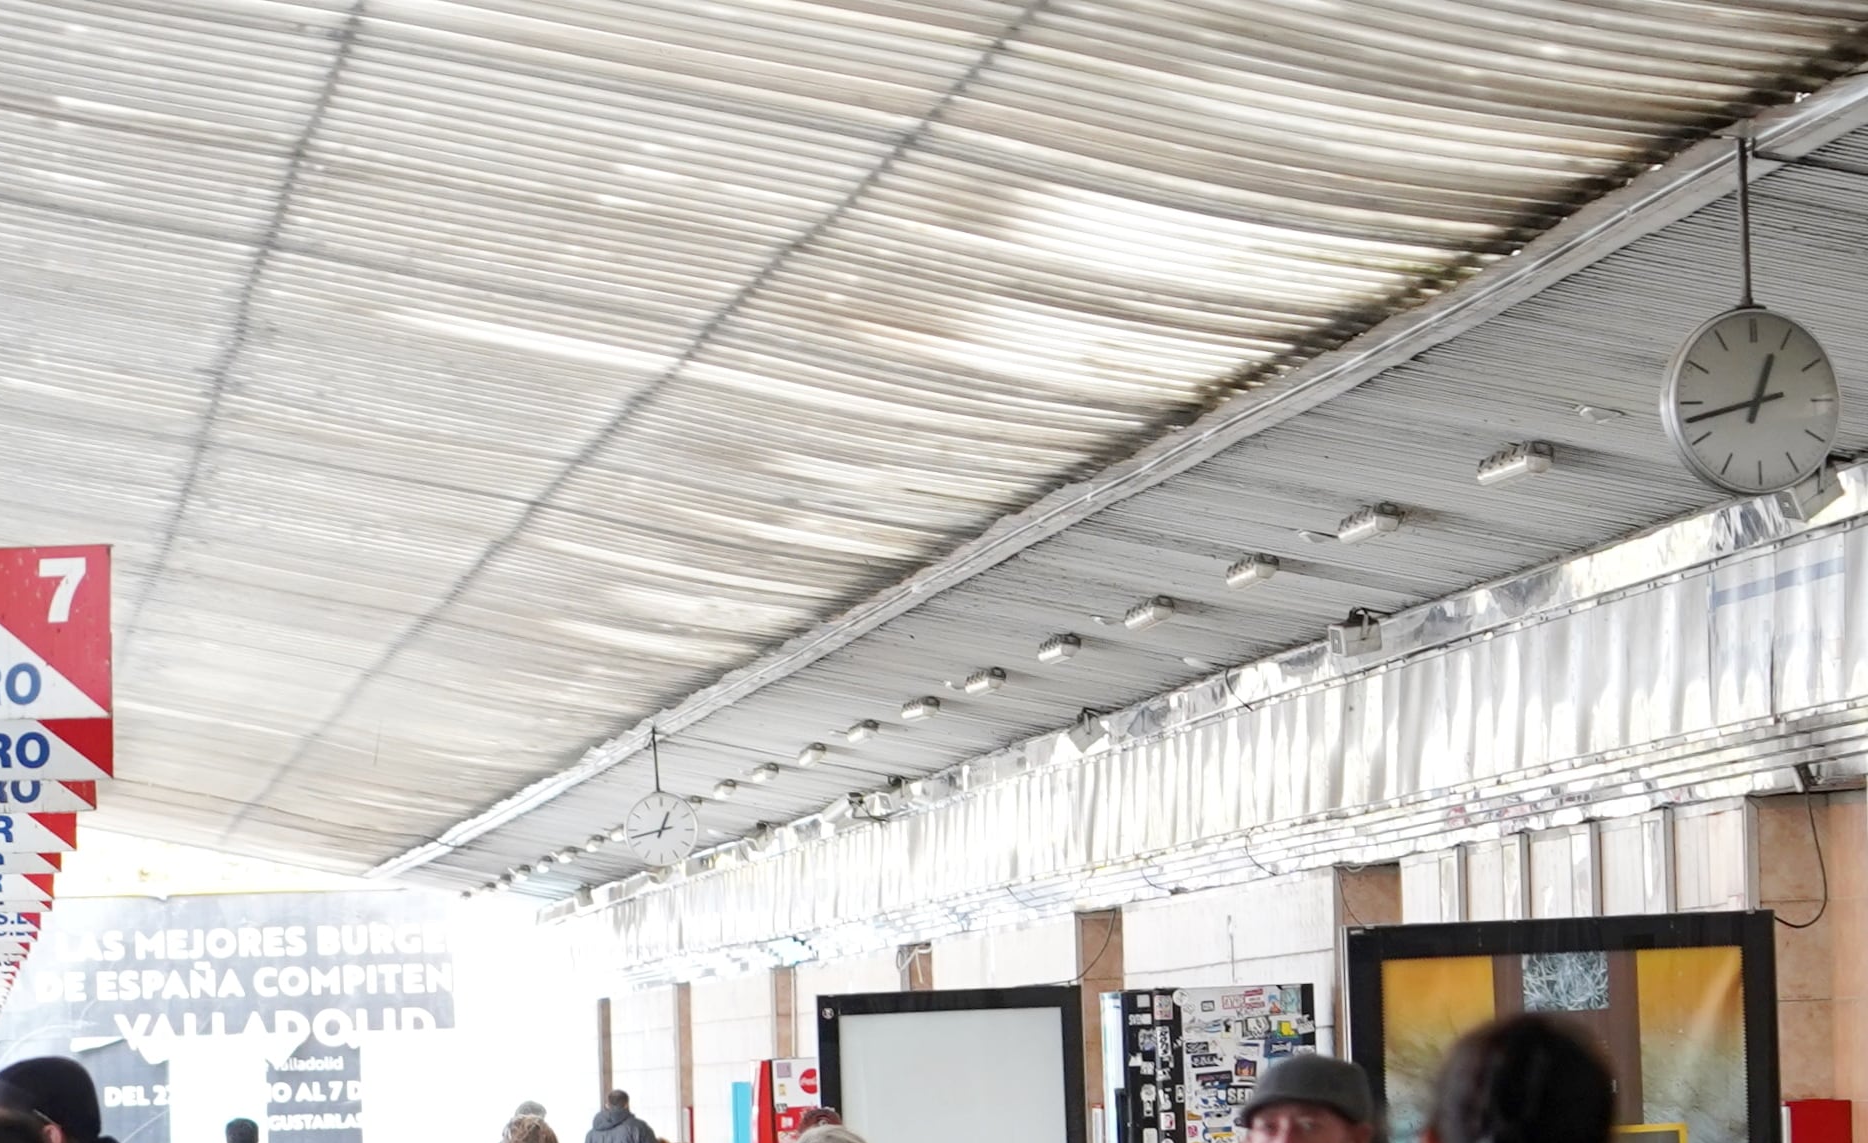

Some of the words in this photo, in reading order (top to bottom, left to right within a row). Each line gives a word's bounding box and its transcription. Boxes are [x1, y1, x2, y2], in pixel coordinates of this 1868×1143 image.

[38, 557, 86, 623] 7
[54, 930, 125, 962] LAS
[135, 926, 308, 960] MEJORES
[316, 922, 452, 956] BURGE
[36, 970, 87, 1002] DE
[96, 961, 245, 1000] ESPAÑA
[253, 963, 452, 998] COMPITEN
[104, 1085, 150, 1107] DEL
[295, 1081, 327, 1102] AL
[328, 1080, 343, 1101] 7
